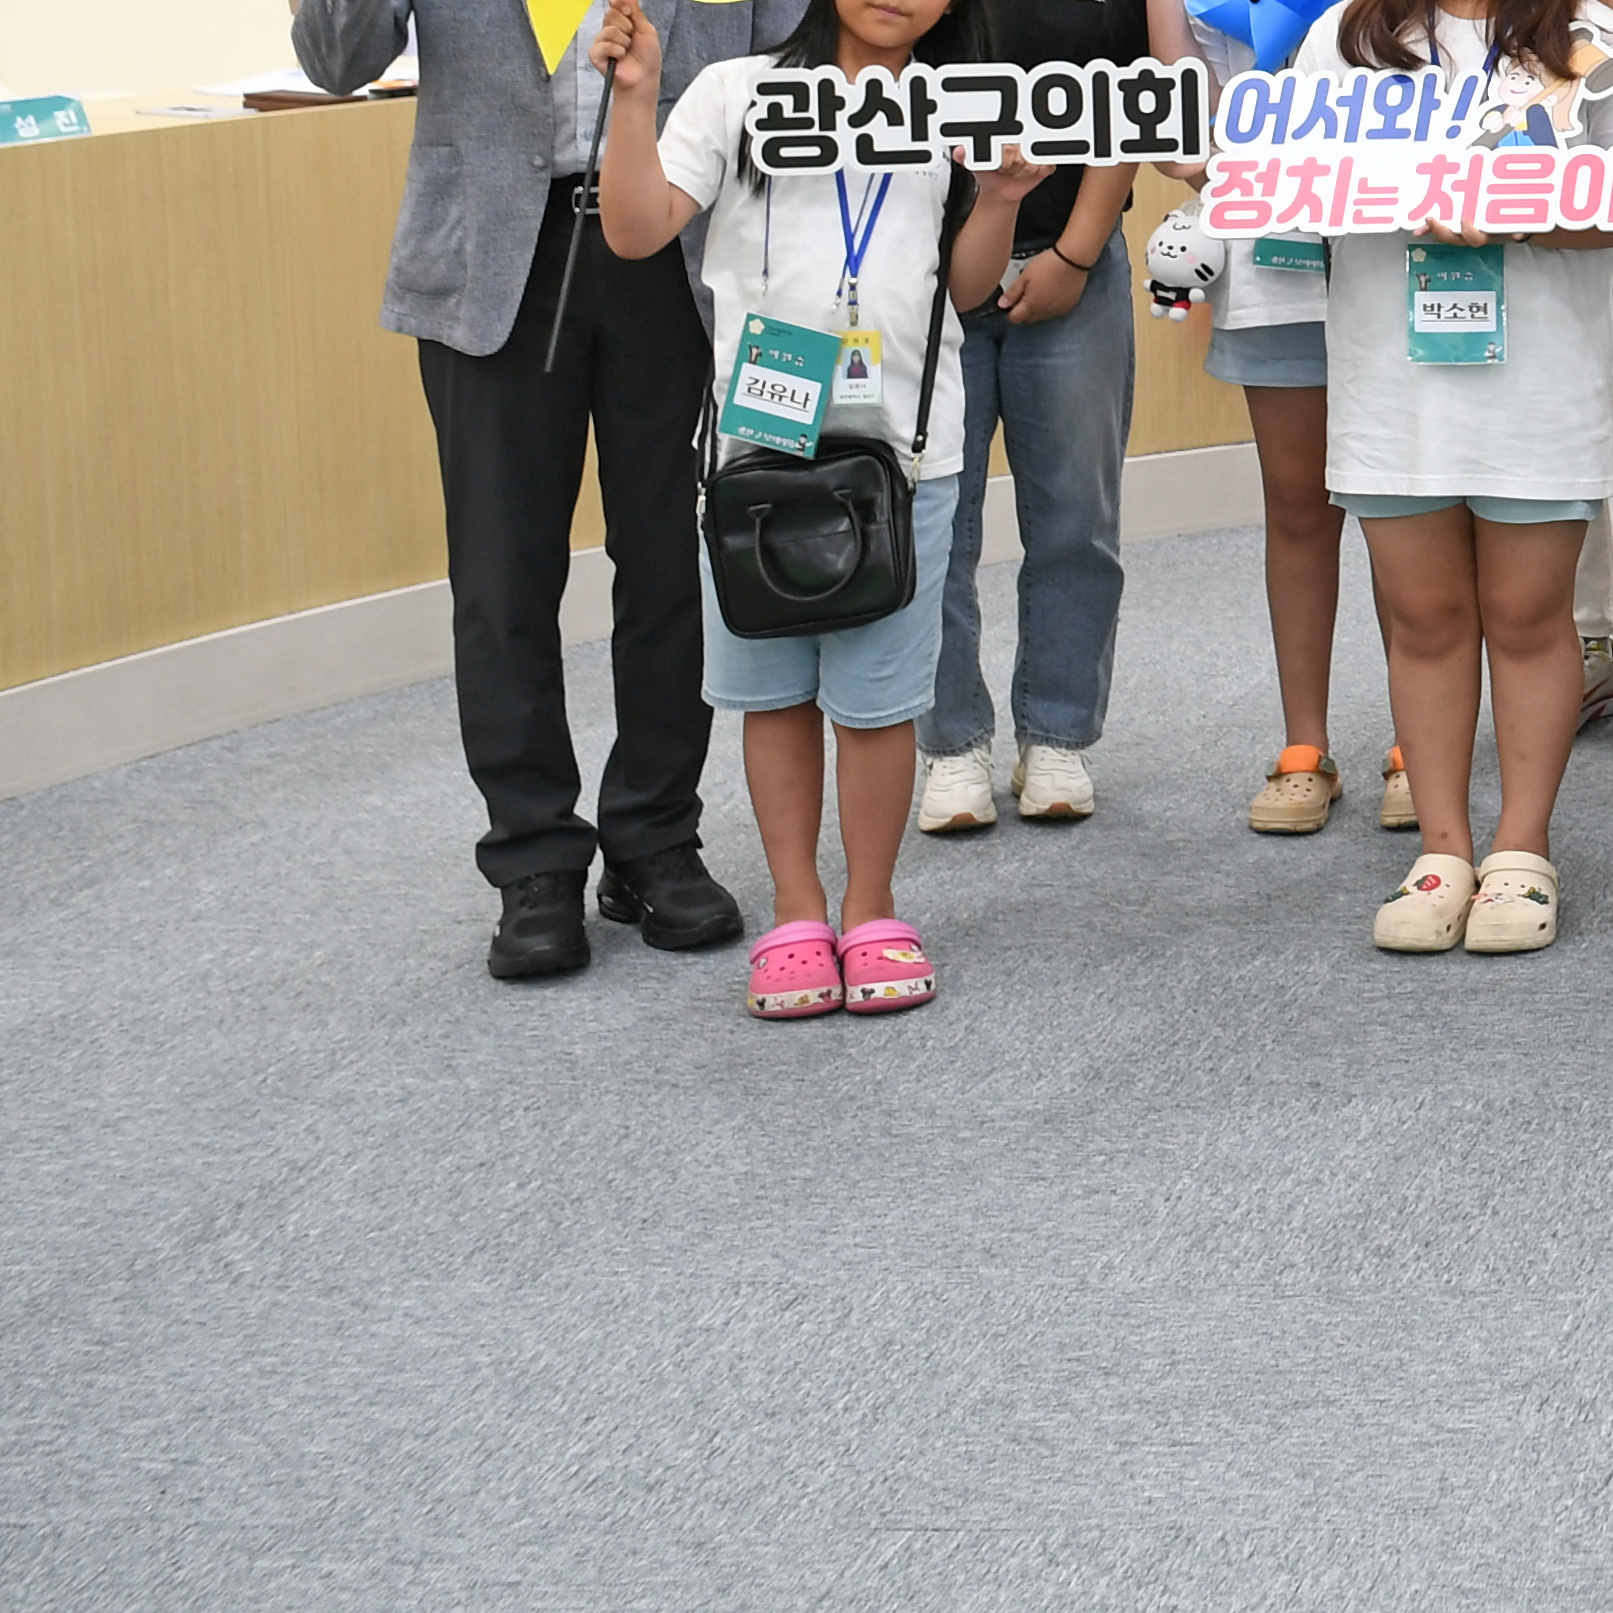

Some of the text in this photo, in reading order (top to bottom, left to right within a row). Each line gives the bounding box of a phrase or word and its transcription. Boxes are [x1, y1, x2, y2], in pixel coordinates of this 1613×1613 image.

[754, 67, 1202, 168] 광산구의회
[1223, 71, 1481, 146] 어서와!
[1208, 154, 1400, 231] 정치는
[1422, 302, 1489, 319] 박소현
[745, 376, 812, 409] 김유나
